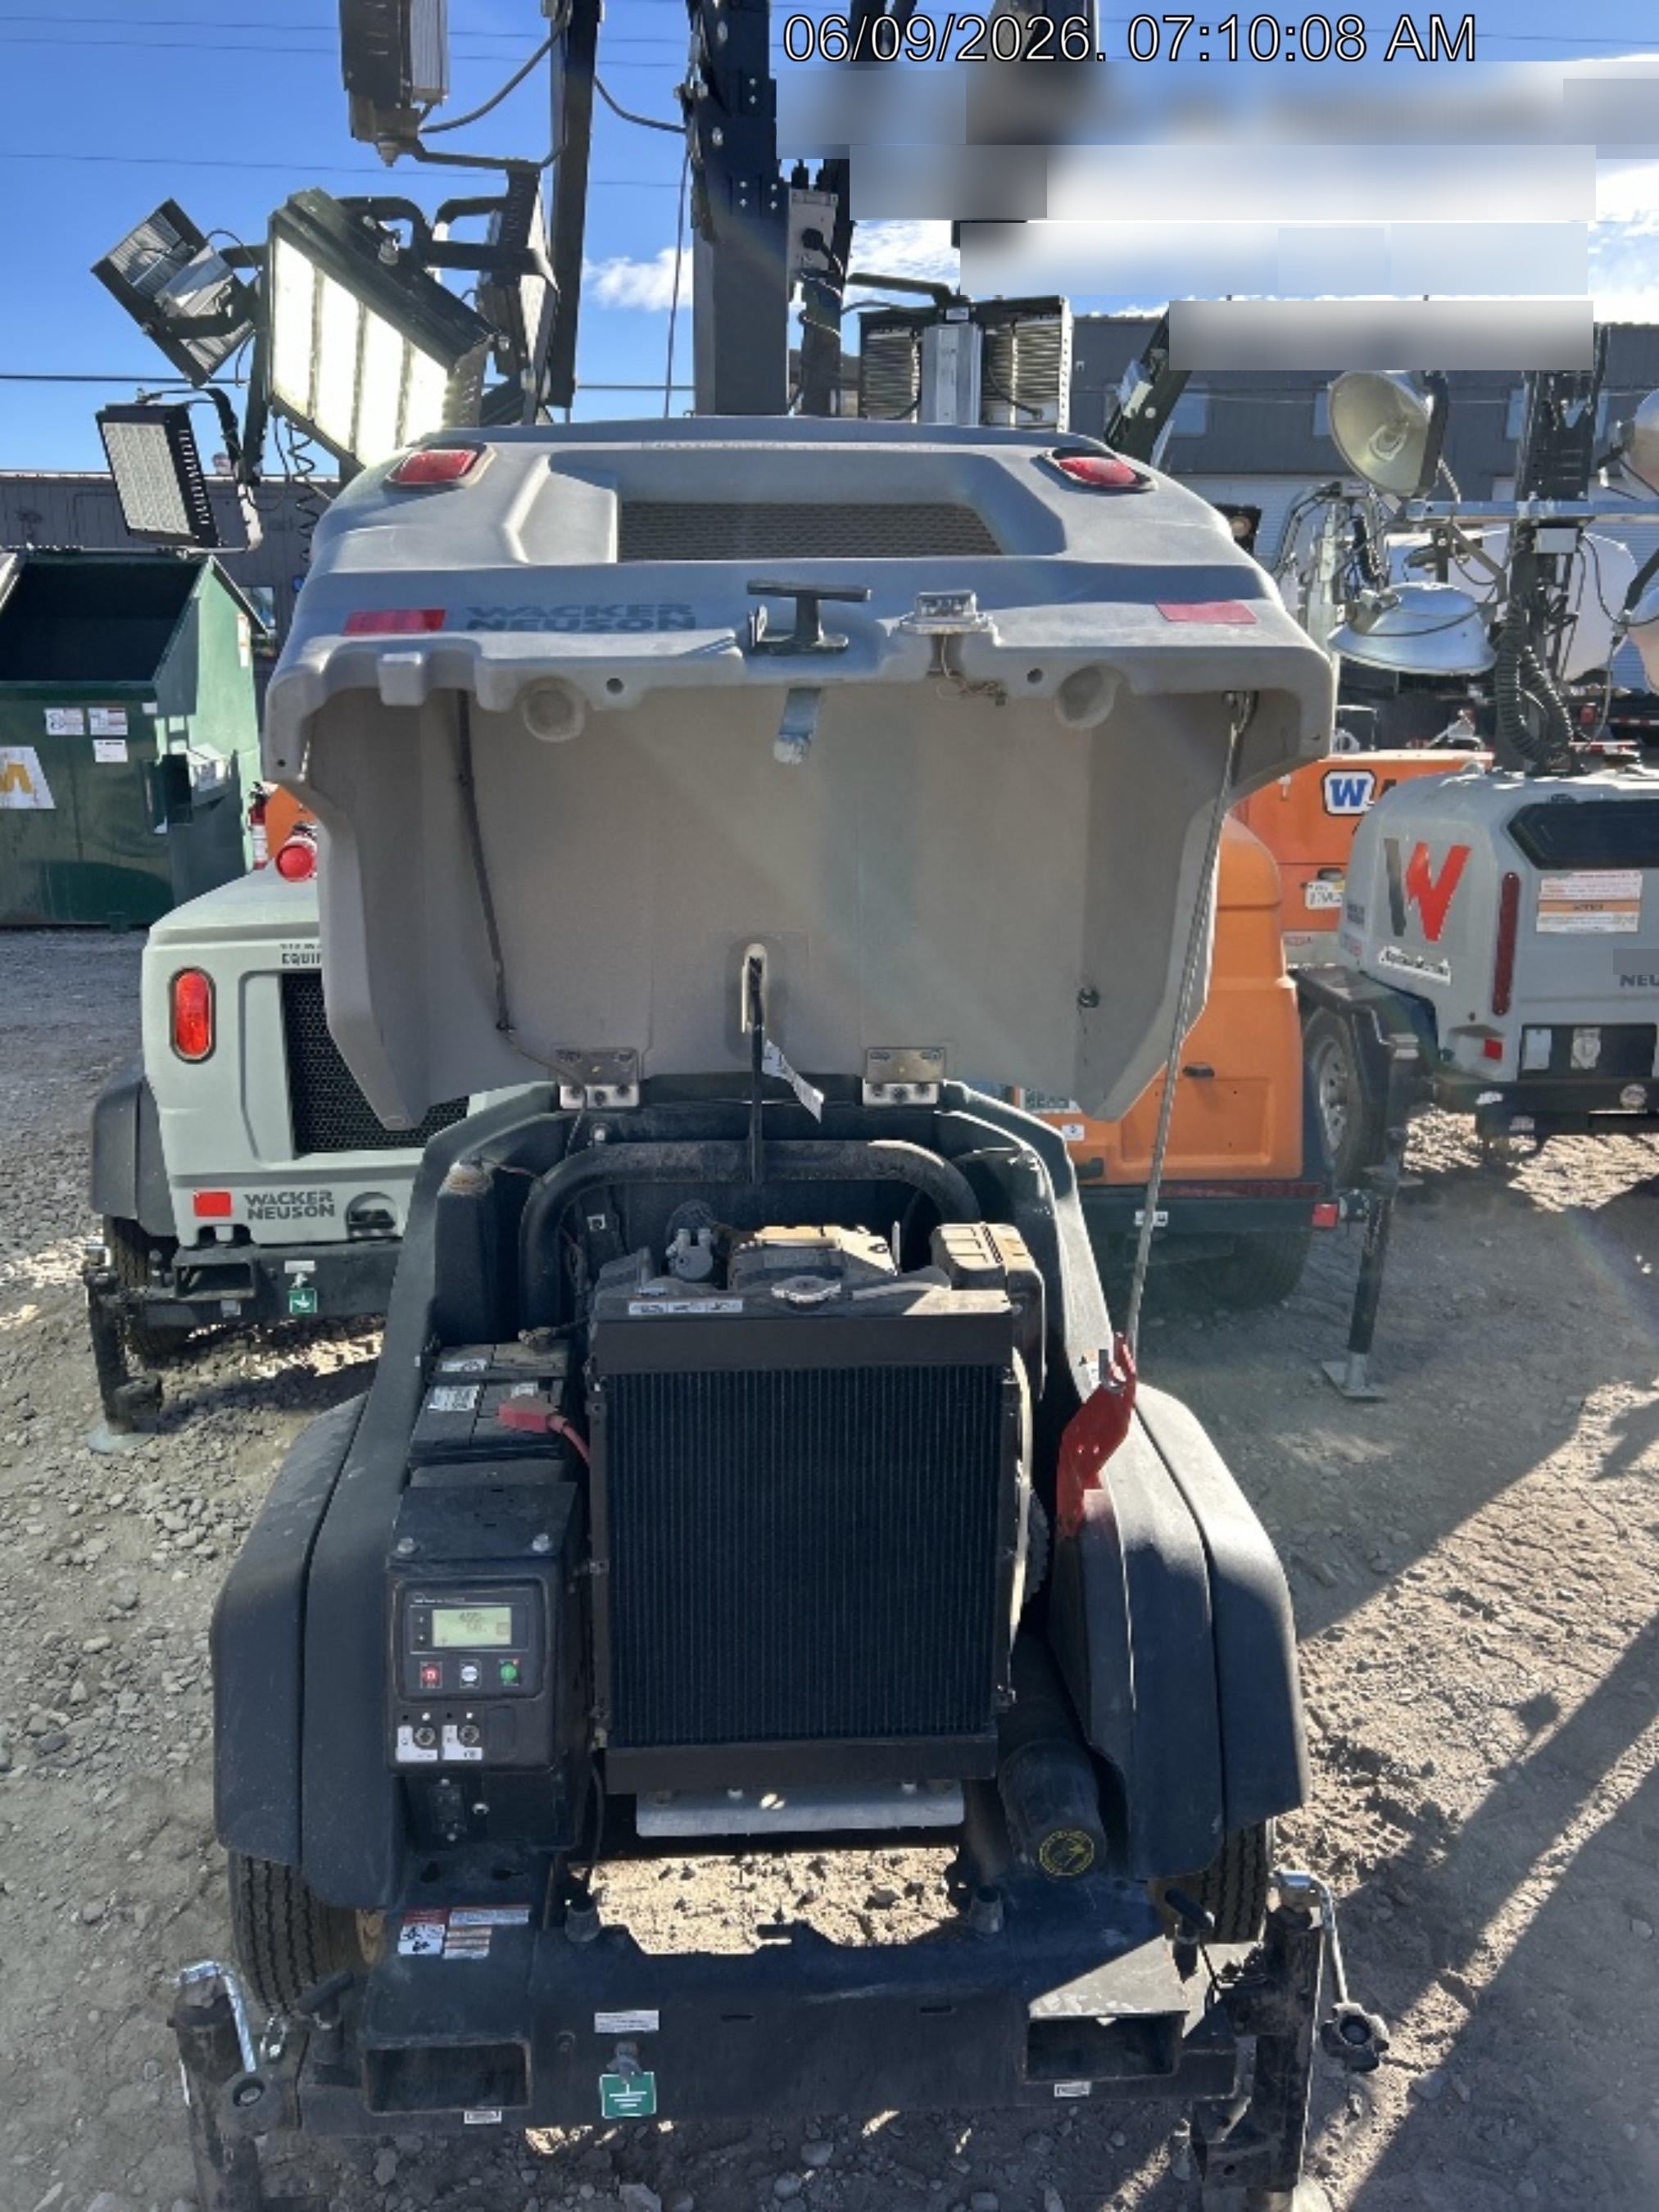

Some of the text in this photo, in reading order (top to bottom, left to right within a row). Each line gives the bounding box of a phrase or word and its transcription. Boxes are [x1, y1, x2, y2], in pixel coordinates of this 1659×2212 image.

[466, 604, 692, 618] WACKER
[467, 618, 696, 631] NEUSON
[243, 1190, 333, 1207] WACKER
[247, 1204, 335, 1220] NEUSON
